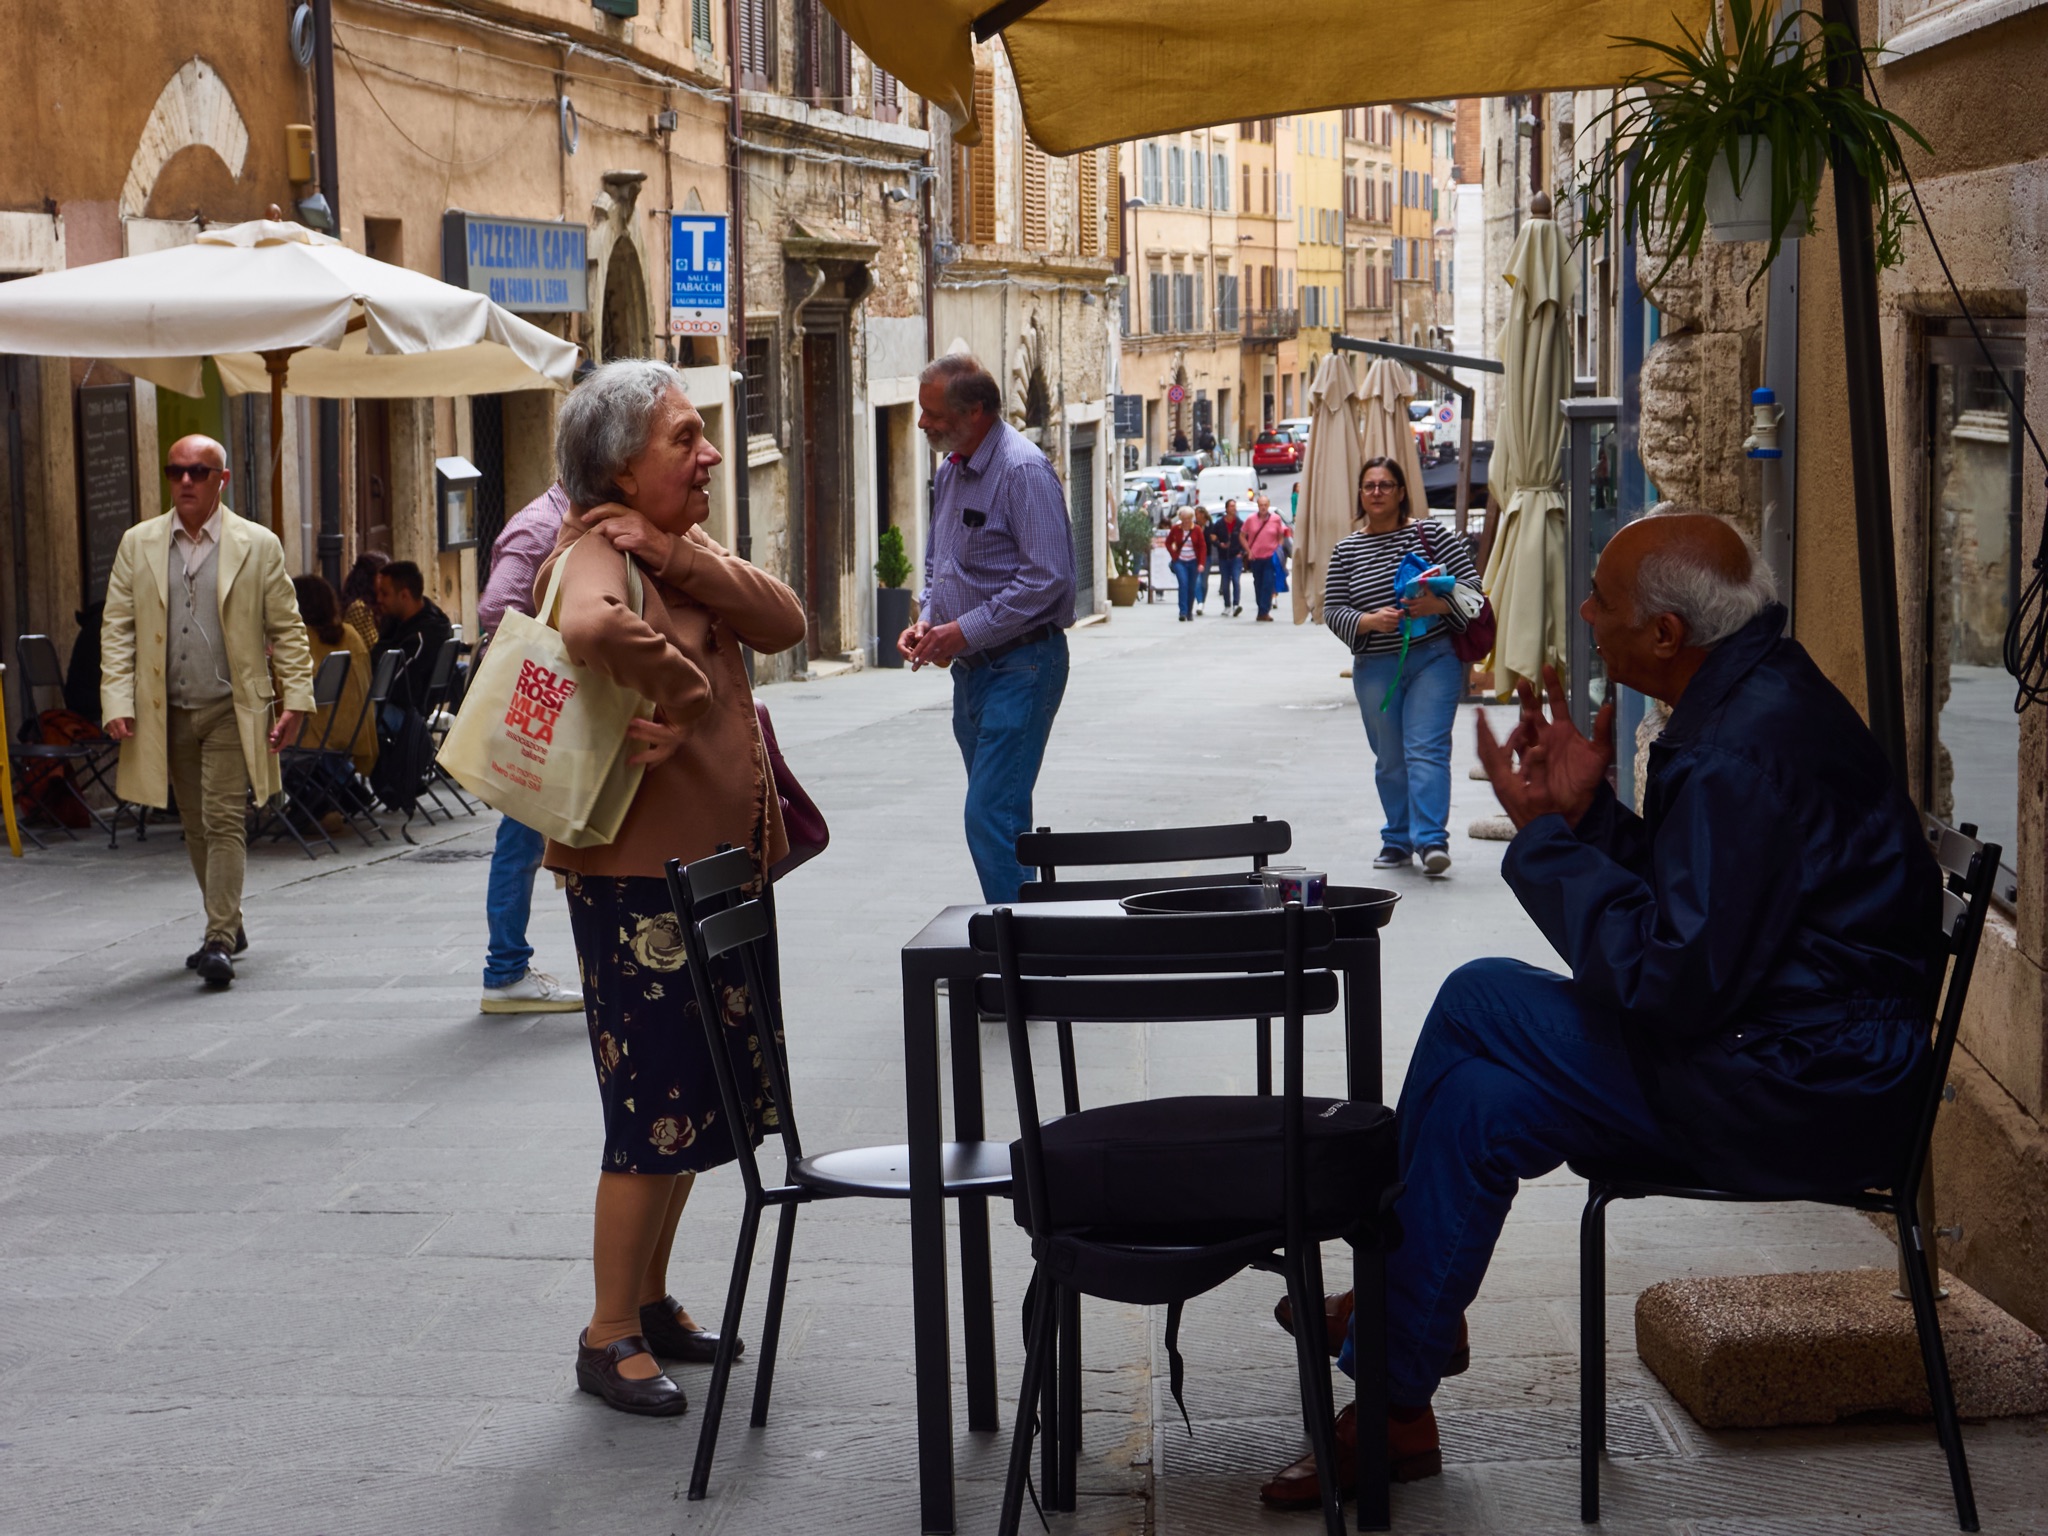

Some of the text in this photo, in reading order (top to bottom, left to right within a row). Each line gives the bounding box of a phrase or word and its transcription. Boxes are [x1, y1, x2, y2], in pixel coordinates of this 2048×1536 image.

[469, 223, 584, 270] PIZZERIA CAPRI
[681, 221, 716, 271] T
[536, 279, 542, 303] A
[676, 282, 722, 292] TABACCHI
[688, 274, 704, 282] SALI
[521, 659, 574, 697] SCLE
[510, 691, 560, 727] MULT
[505, 729, 548, 756] associazione
[520, 747, 546, 766] italiana
